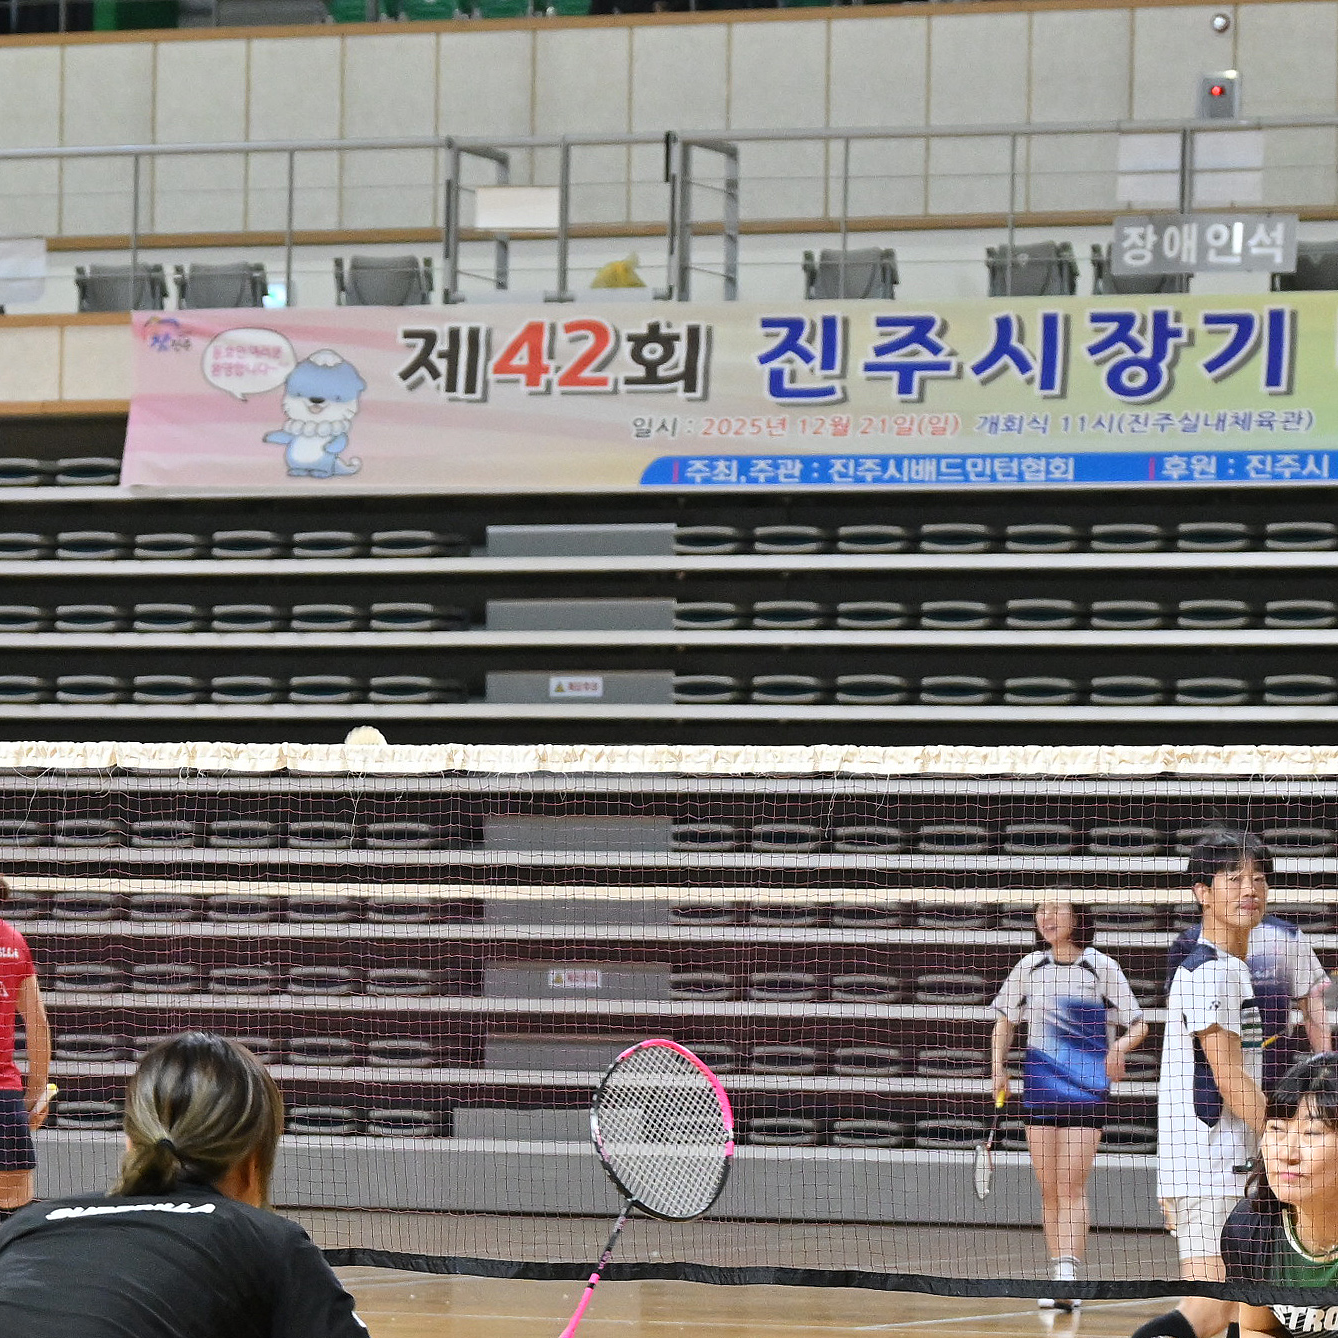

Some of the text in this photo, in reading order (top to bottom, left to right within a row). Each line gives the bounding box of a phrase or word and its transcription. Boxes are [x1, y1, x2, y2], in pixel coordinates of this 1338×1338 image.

[1121, 221, 1286, 267] 장애인석
[397, 319, 703, 397] 제42회
[756, 307, 1289, 400] 진주시장기
[632, 416, 678, 438] 일시
[701, 416, 787, 437] 2025년
[799, 415, 850, 437] 12월
[860, 414, 960, 437] 21일(일)
[975, 413, 1049, 436] 개회식
[1061, 410, 1314, 434] 11시(진주실내체육관)
[827, 456, 1075, 483] 진주시배드민턴협회
[1161, 454, 1218, 480] 후원
[1244, 453, 1330, 479] 진주시
